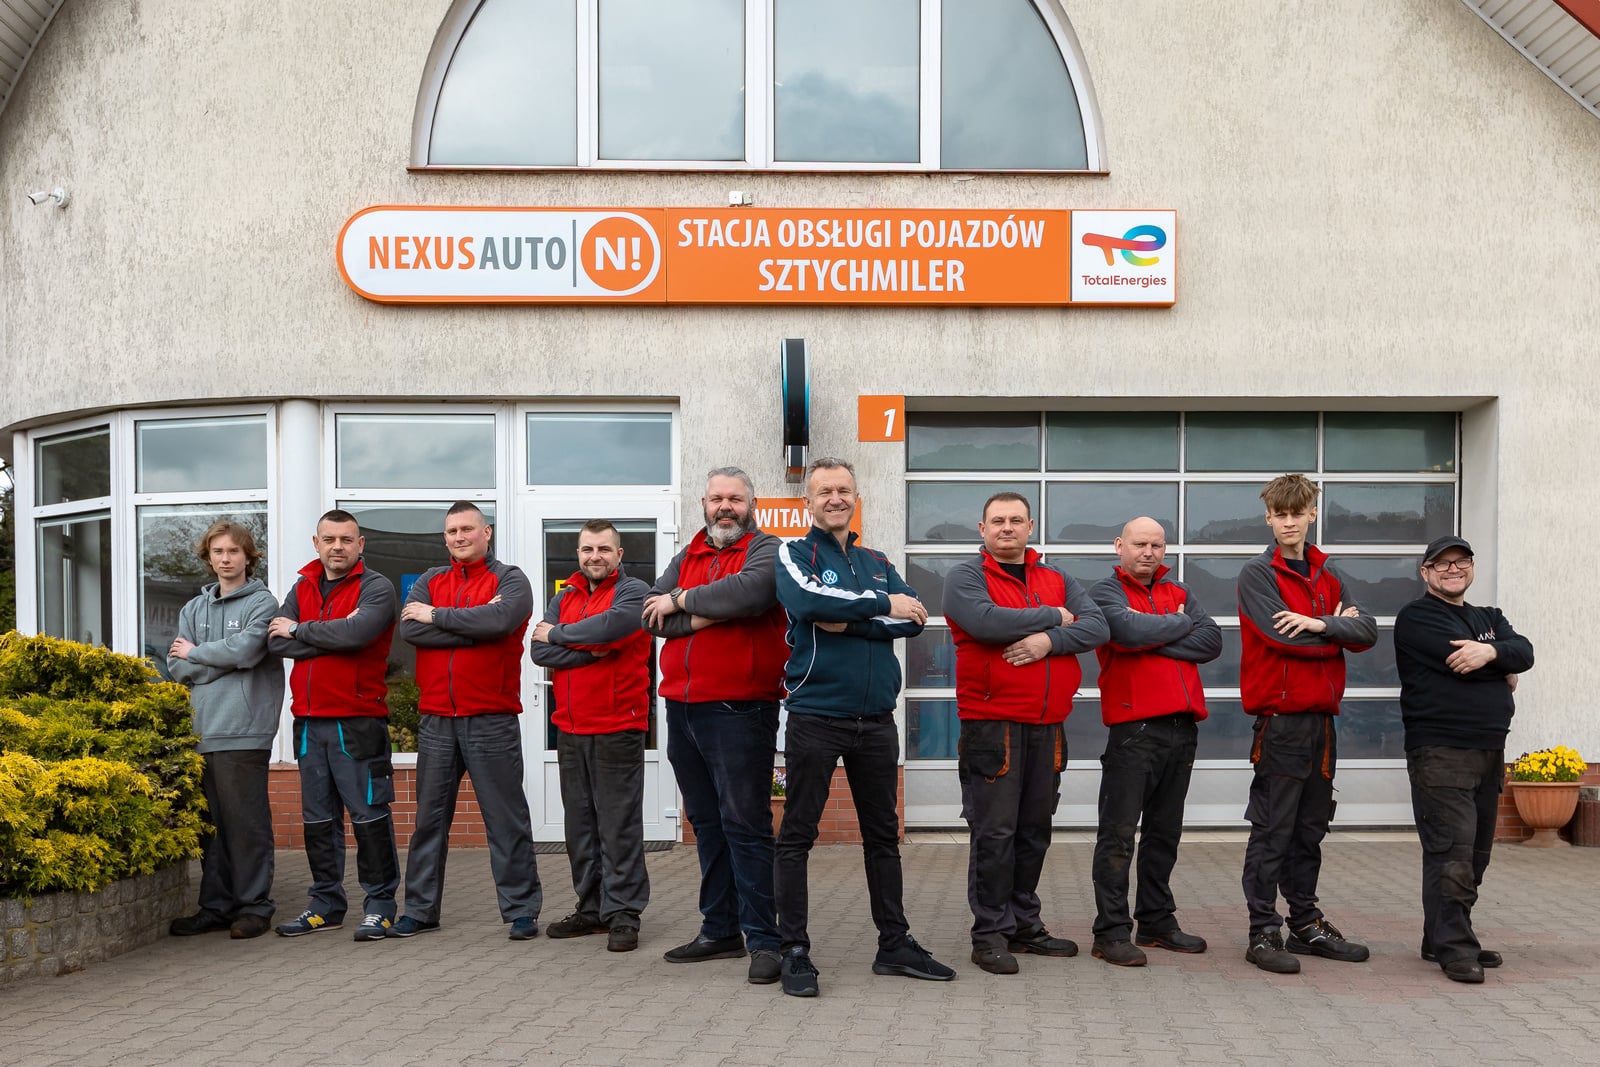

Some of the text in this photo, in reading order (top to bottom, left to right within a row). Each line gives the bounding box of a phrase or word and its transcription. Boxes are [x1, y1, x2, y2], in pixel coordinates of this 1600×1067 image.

[677, 213, 1045, 249] STACJA OBSŁUGI POJAZDÓW
[595, 236, 642, 271] N!
[758, 258, 965, 292] SZTYCHMILER
[1081, 274, 1167, 288] TotalEnergies
[883, 408, 897, 437] 1
[755, 508, 814, 528] WITAM
